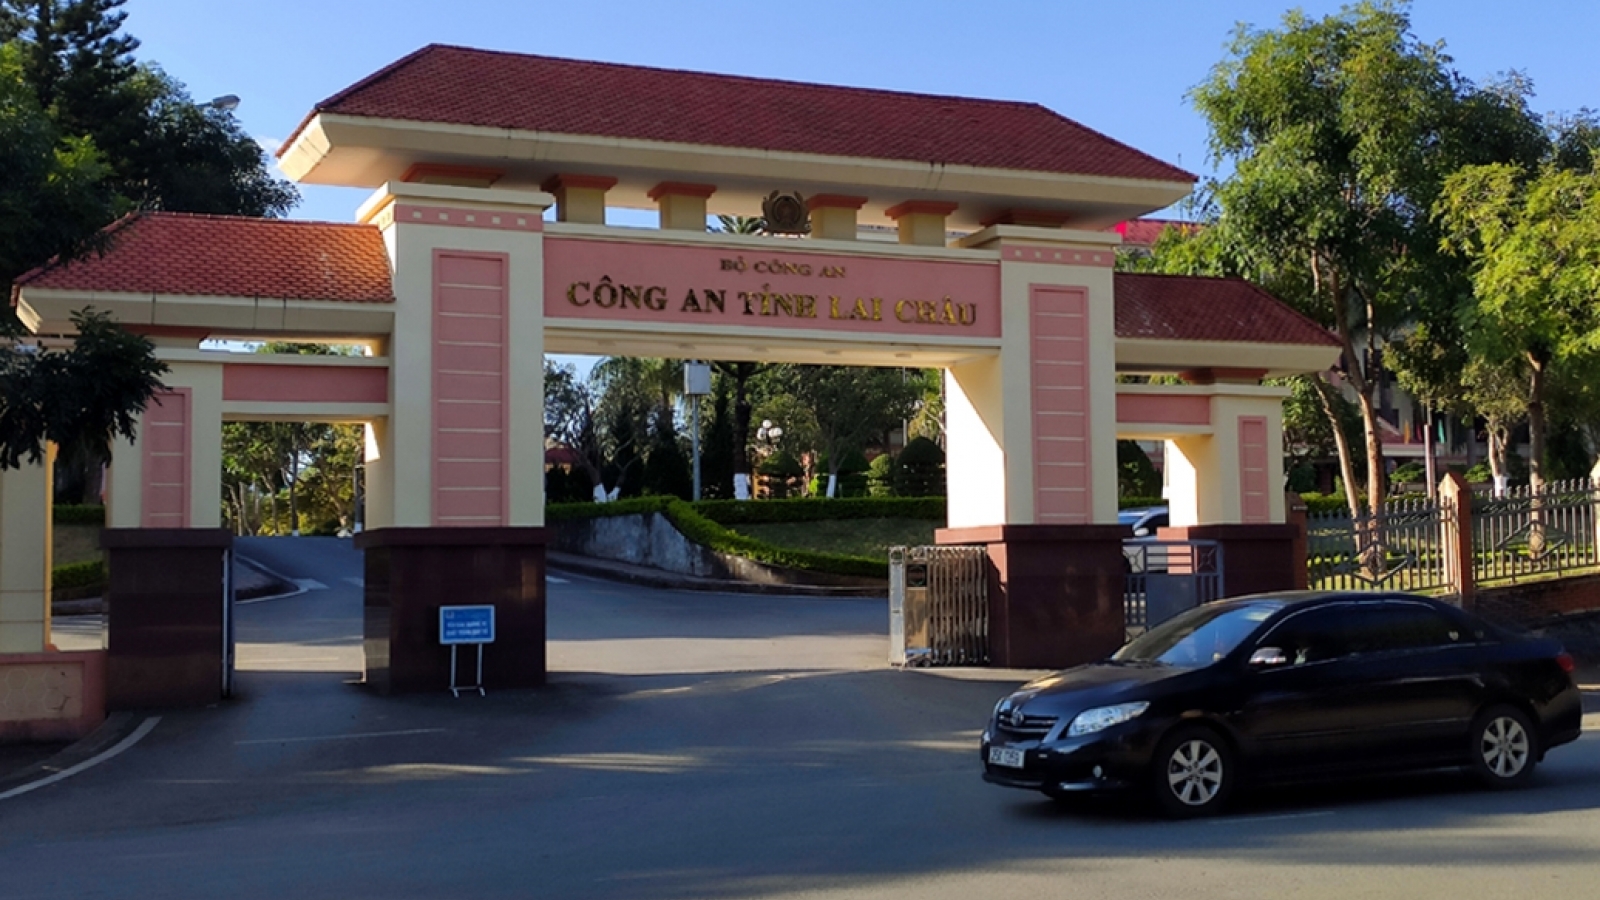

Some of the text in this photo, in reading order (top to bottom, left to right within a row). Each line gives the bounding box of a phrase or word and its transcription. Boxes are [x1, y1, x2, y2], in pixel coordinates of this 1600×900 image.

[720, 256, 846, 278] BỘ CÔNG AN
[567, 275, 977, 326] CÔNG AN TỈNH LAI CHÂU
